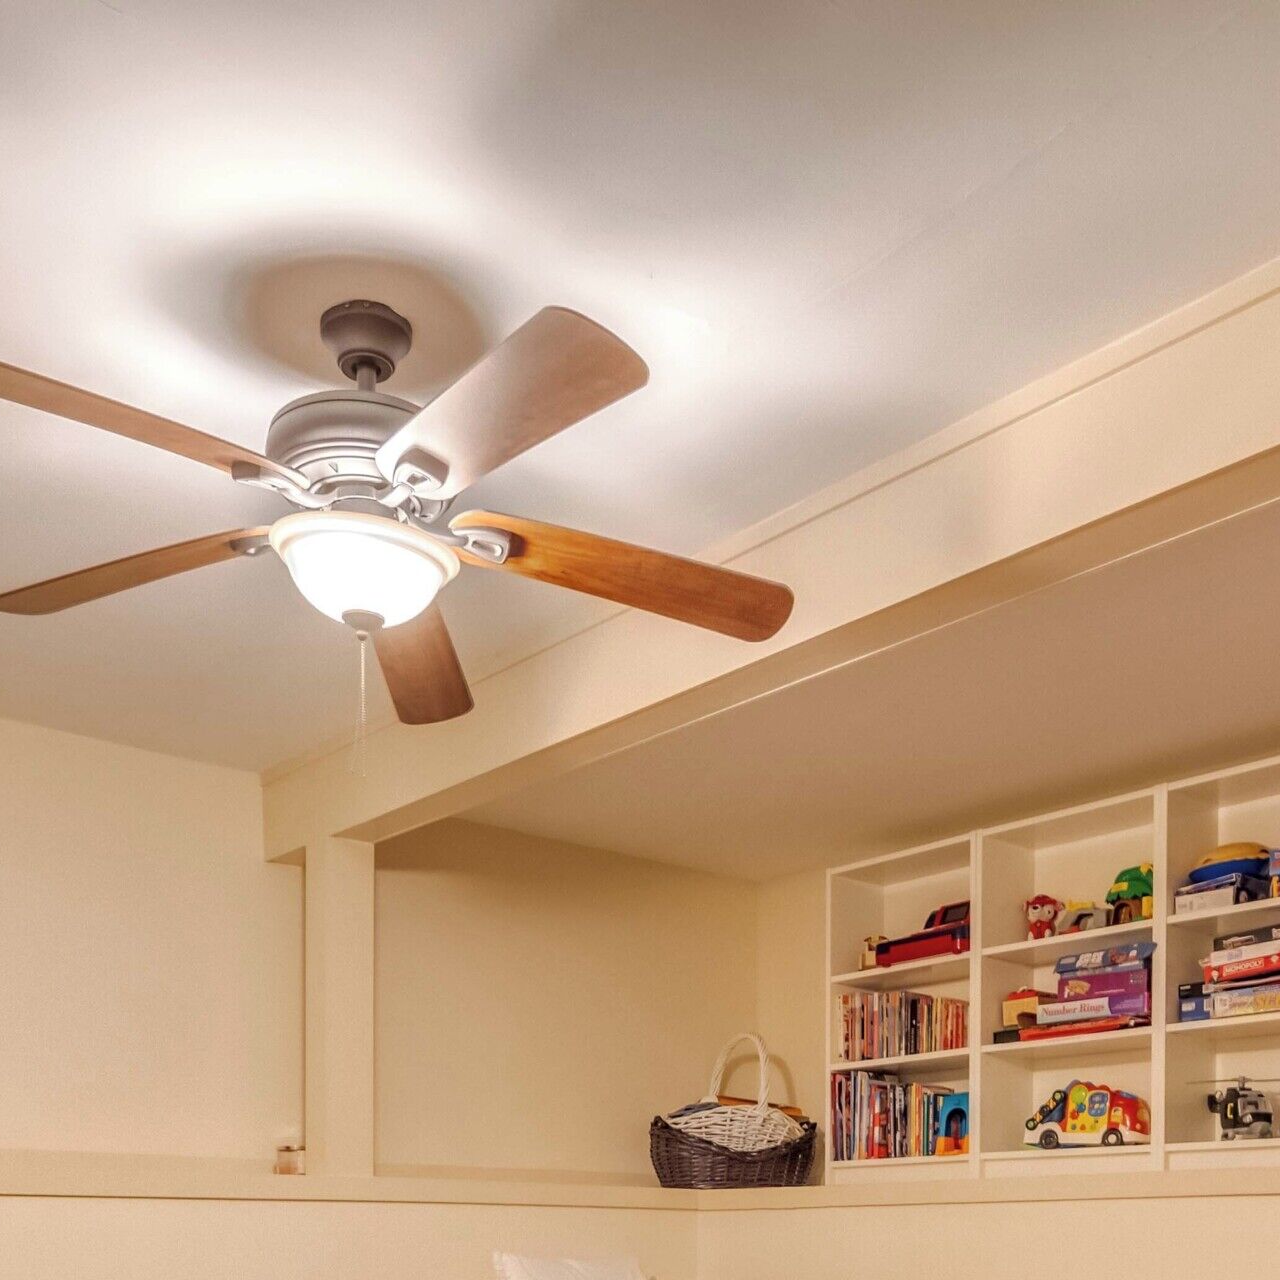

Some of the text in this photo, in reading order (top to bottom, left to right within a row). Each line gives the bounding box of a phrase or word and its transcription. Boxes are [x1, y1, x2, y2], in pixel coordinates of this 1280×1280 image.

[1225, 959, 1263, 975] MONOPOLY
[1042, 1005, 1077, 1017] Number
[1079, 1003, 1105, 1014] Rings
